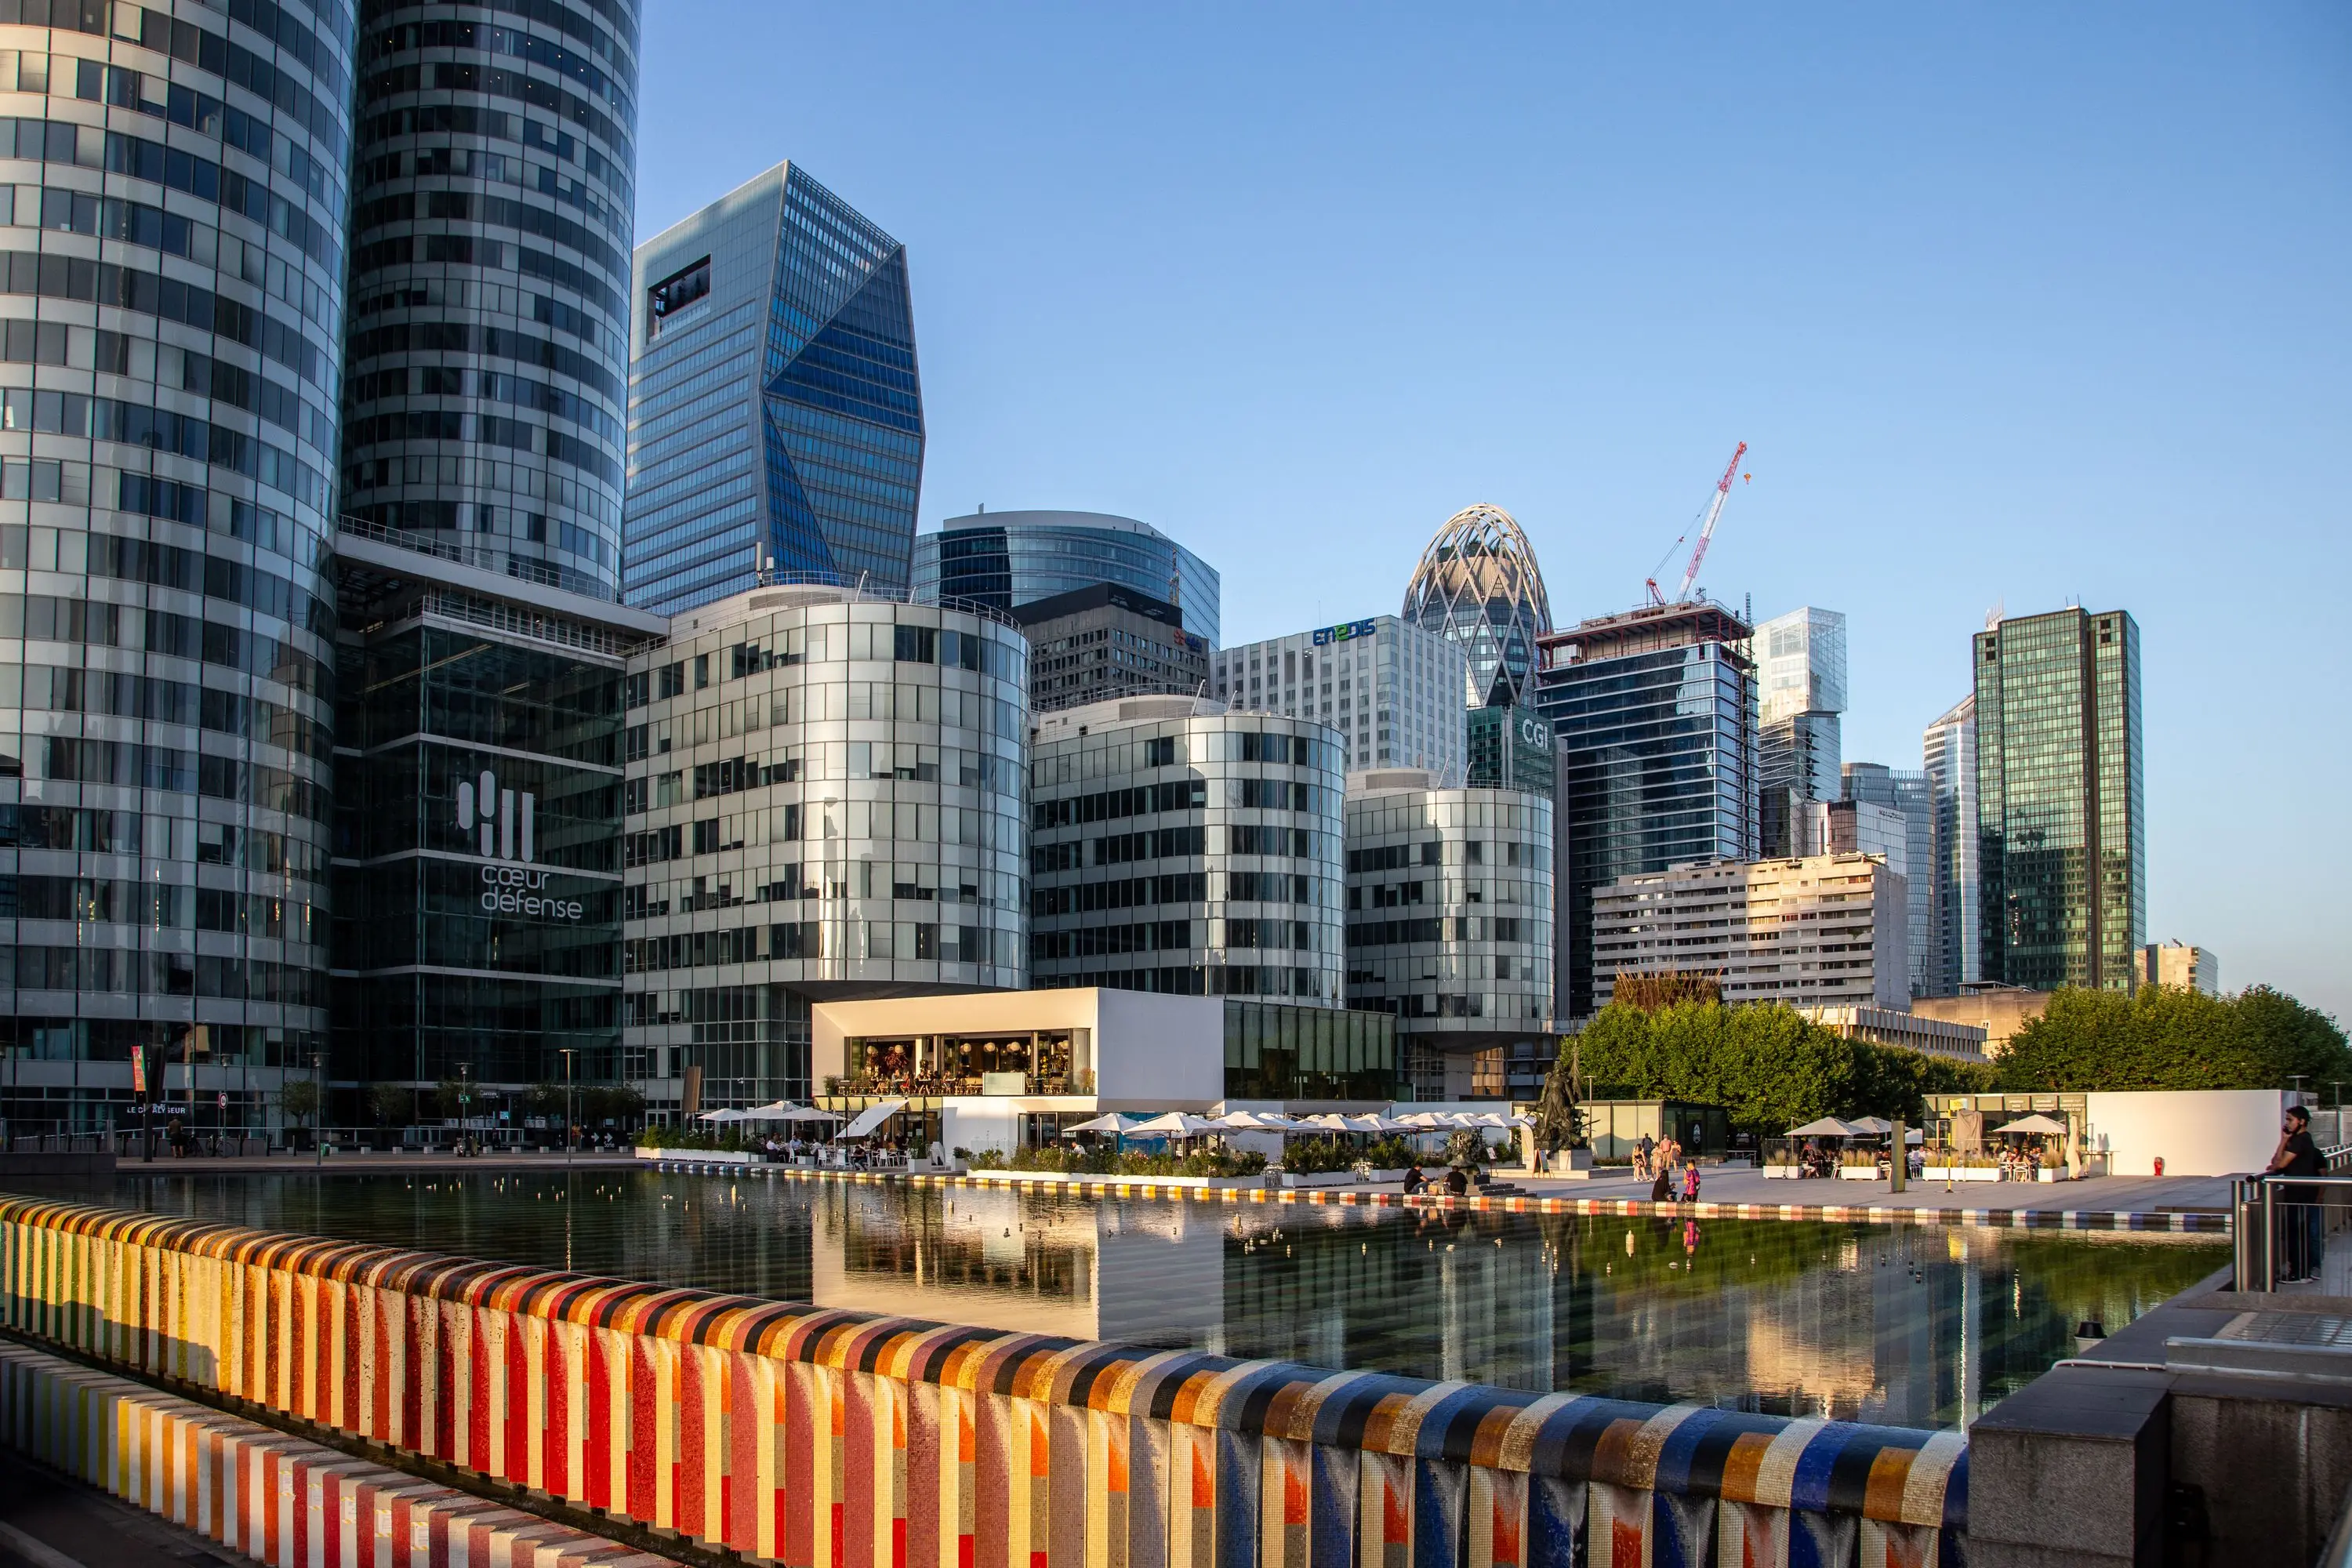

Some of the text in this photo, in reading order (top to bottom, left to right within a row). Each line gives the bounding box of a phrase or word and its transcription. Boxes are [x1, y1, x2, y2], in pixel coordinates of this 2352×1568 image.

[1523, 718, 1548, 750] CGI
[481, 866, 550, 890] cœur
[481, 886, 583, 920] défense
